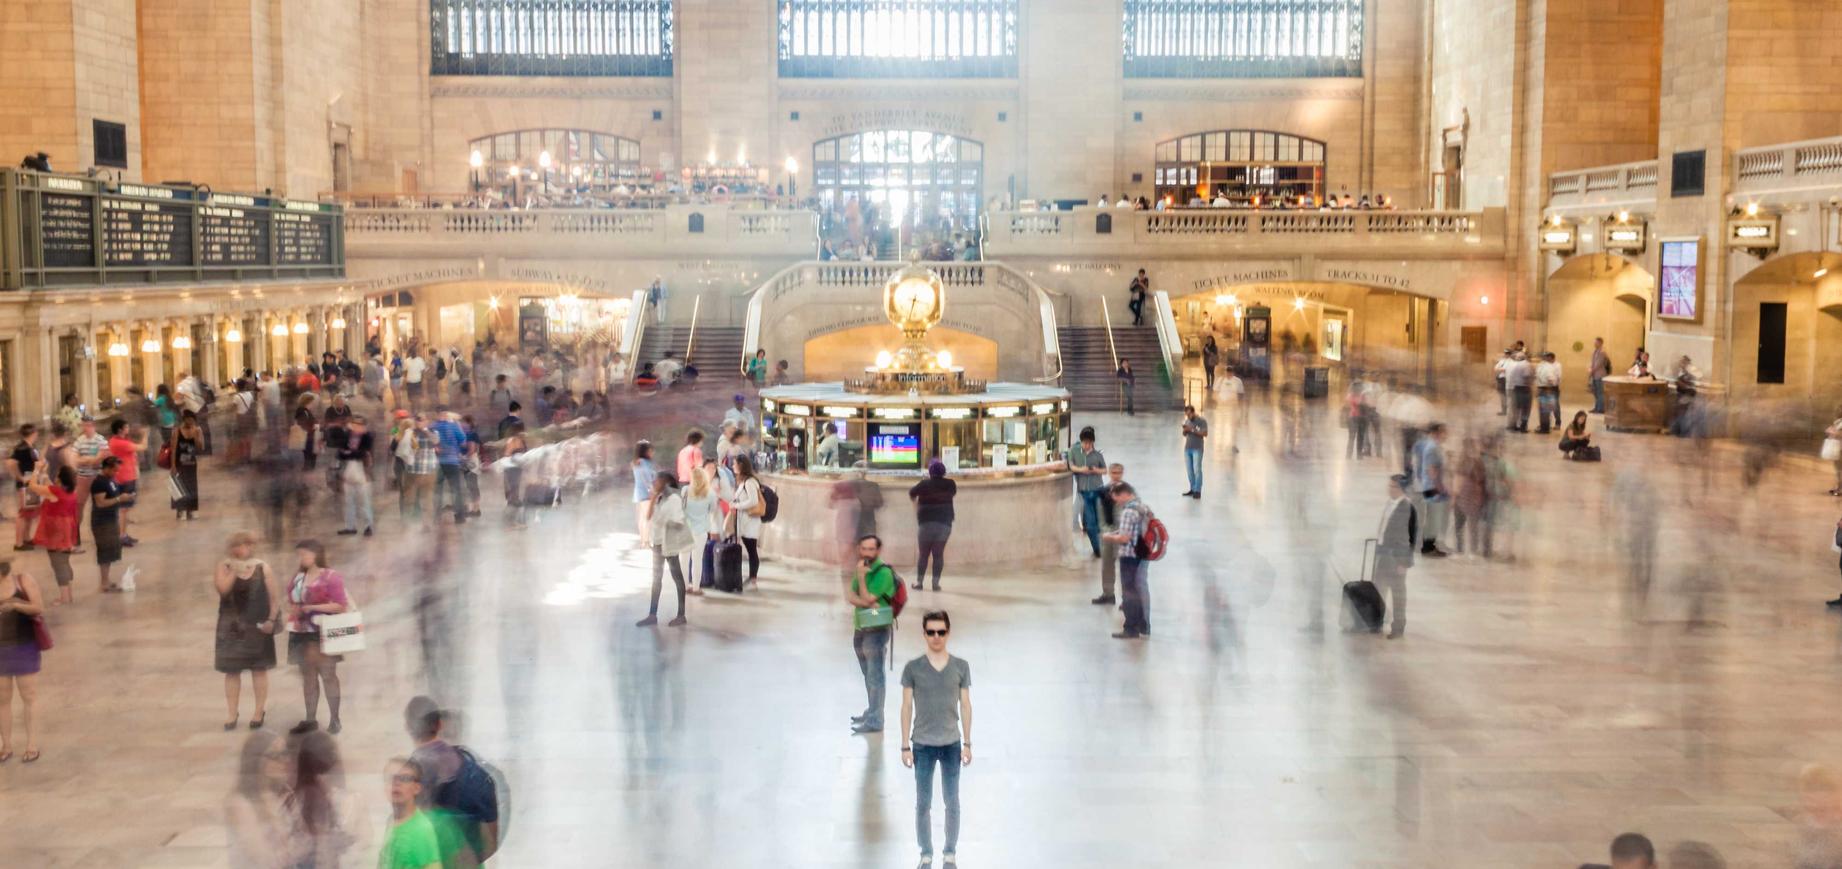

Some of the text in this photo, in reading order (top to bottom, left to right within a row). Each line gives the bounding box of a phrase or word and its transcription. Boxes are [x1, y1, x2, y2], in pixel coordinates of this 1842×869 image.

[369, 267, 474, 289] TICKET MACHINES
[511, 268, 553, 281] SUBWAY
[1193, 269, 1289, 289] TICKET MACHINES
[1327, 269, 1368, 281] TRACKS
[1383, 274, 1397, 285] TO
[1254, 287, 1292, 296] WAITING
[898, 372, 945, 382] Information
